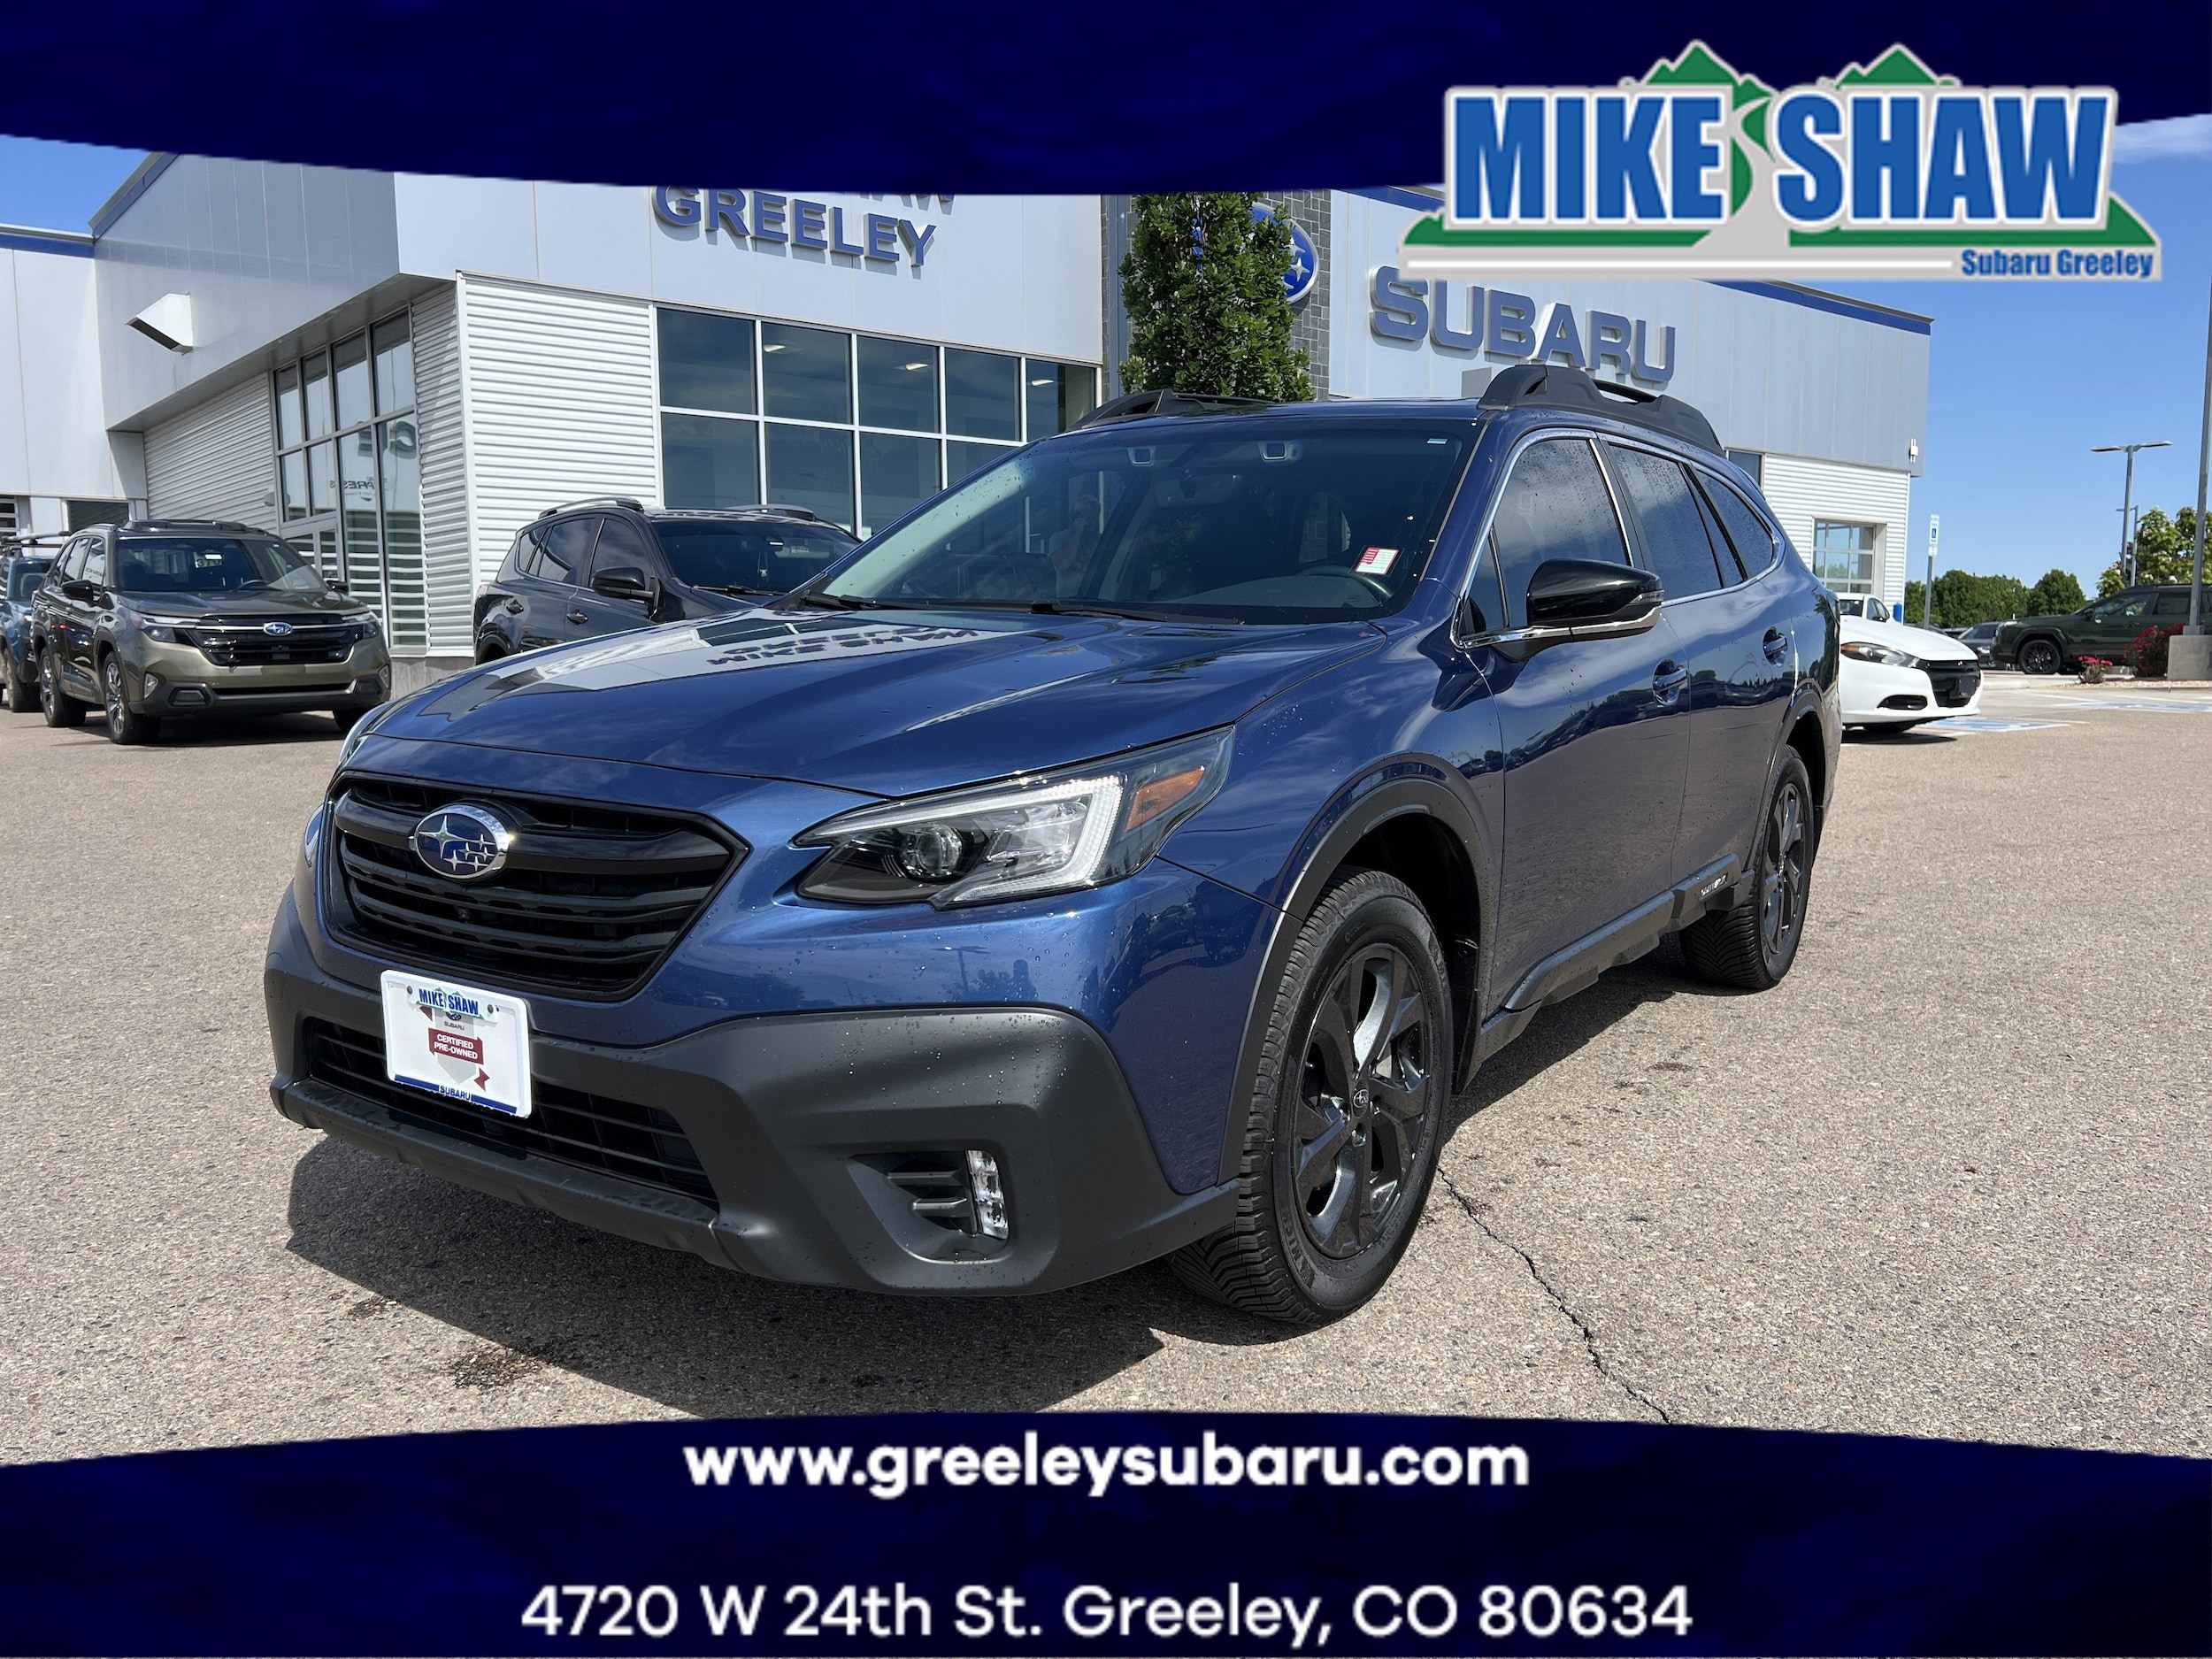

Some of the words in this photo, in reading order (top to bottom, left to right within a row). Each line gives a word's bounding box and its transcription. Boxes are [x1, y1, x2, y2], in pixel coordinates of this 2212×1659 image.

[653, 185, 937, 267] GREELEY
[1370, 265, 1676, 383] SUBARU
[419, 988, 445, 1008] MIKE
[448, 994, 479, 1017] SHAW
[444, 1020, 465, 1031] SUBARU
[434, 1041, 479, 1060] PRE-OWNED
[436, 1033, 474, 1050] CERTIFIED
[440, 1084, 471, 1102] SUBARU
